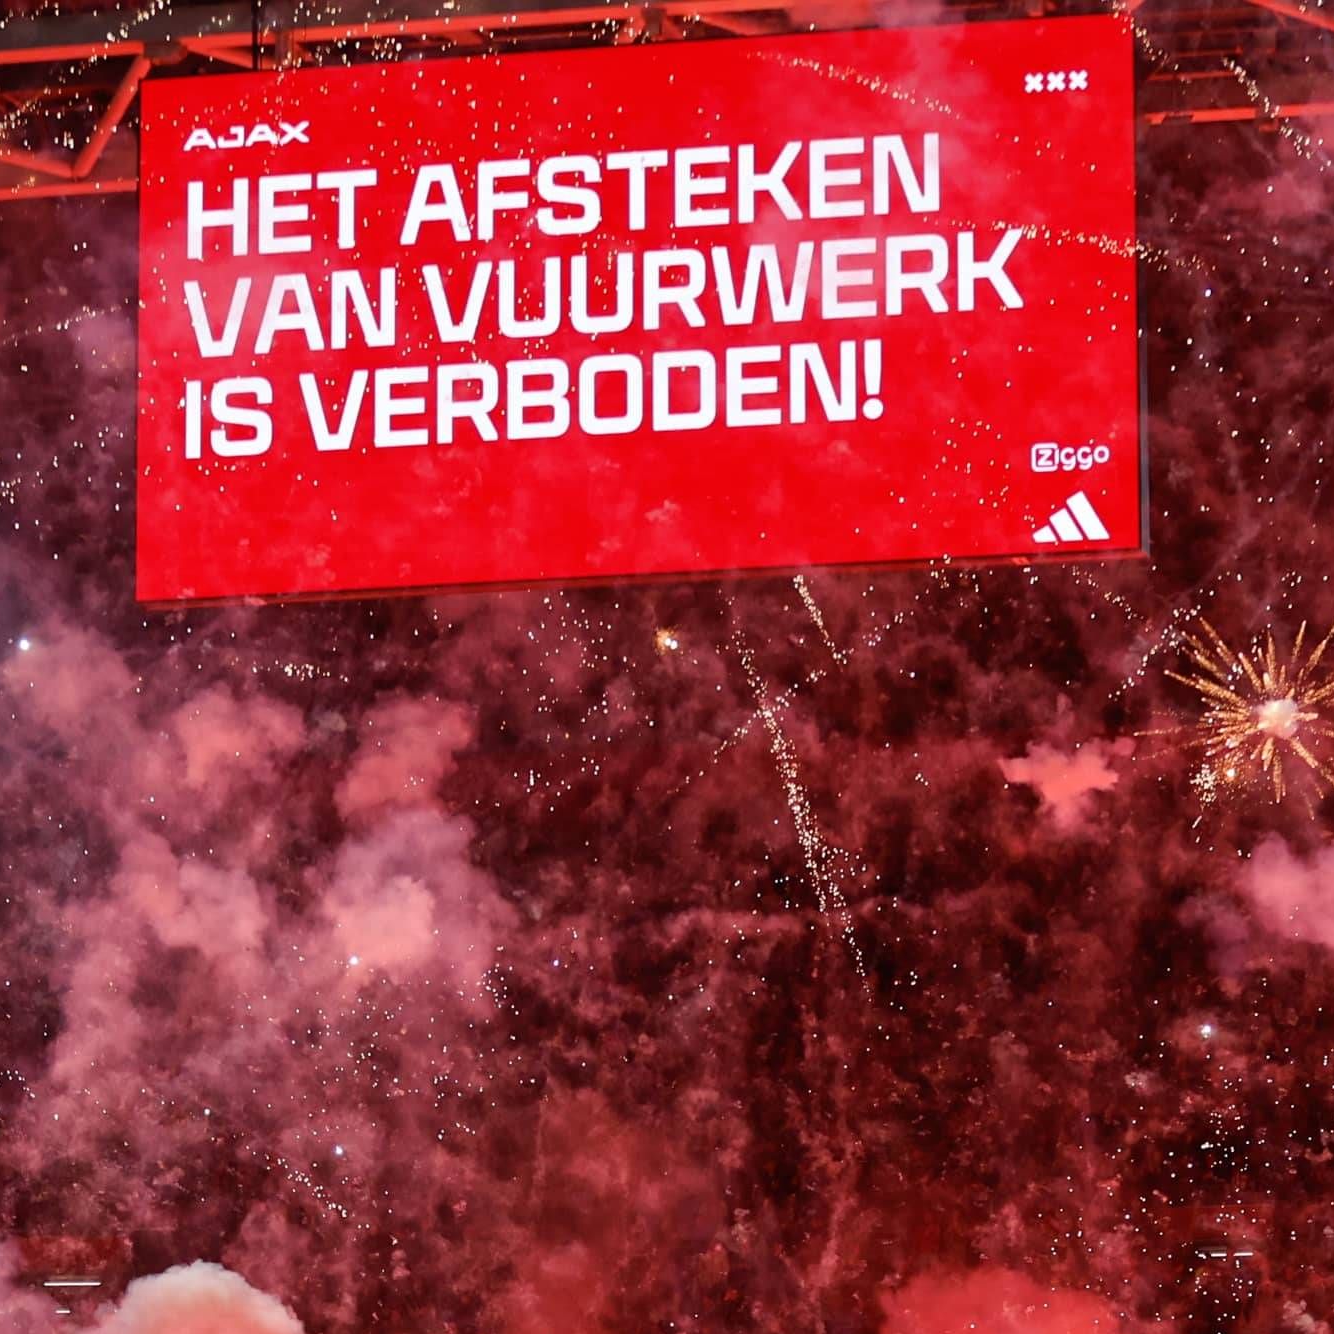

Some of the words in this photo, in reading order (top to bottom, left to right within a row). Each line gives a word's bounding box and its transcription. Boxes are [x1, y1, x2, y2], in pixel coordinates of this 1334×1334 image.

[183, 121, 310, 151] AJAX
[188, 169, 377, 261] HET
[400, 132, 940, 246] AFSTEKEN
[183, 267, 398, 358] VAN
[422, 226, 1025, 344] VUURWERK
[185, 376, 273, 459] IS
[299, 339, 883, 452] VERBODEN!
[1031, 442, 1110, 472] Ziggo
